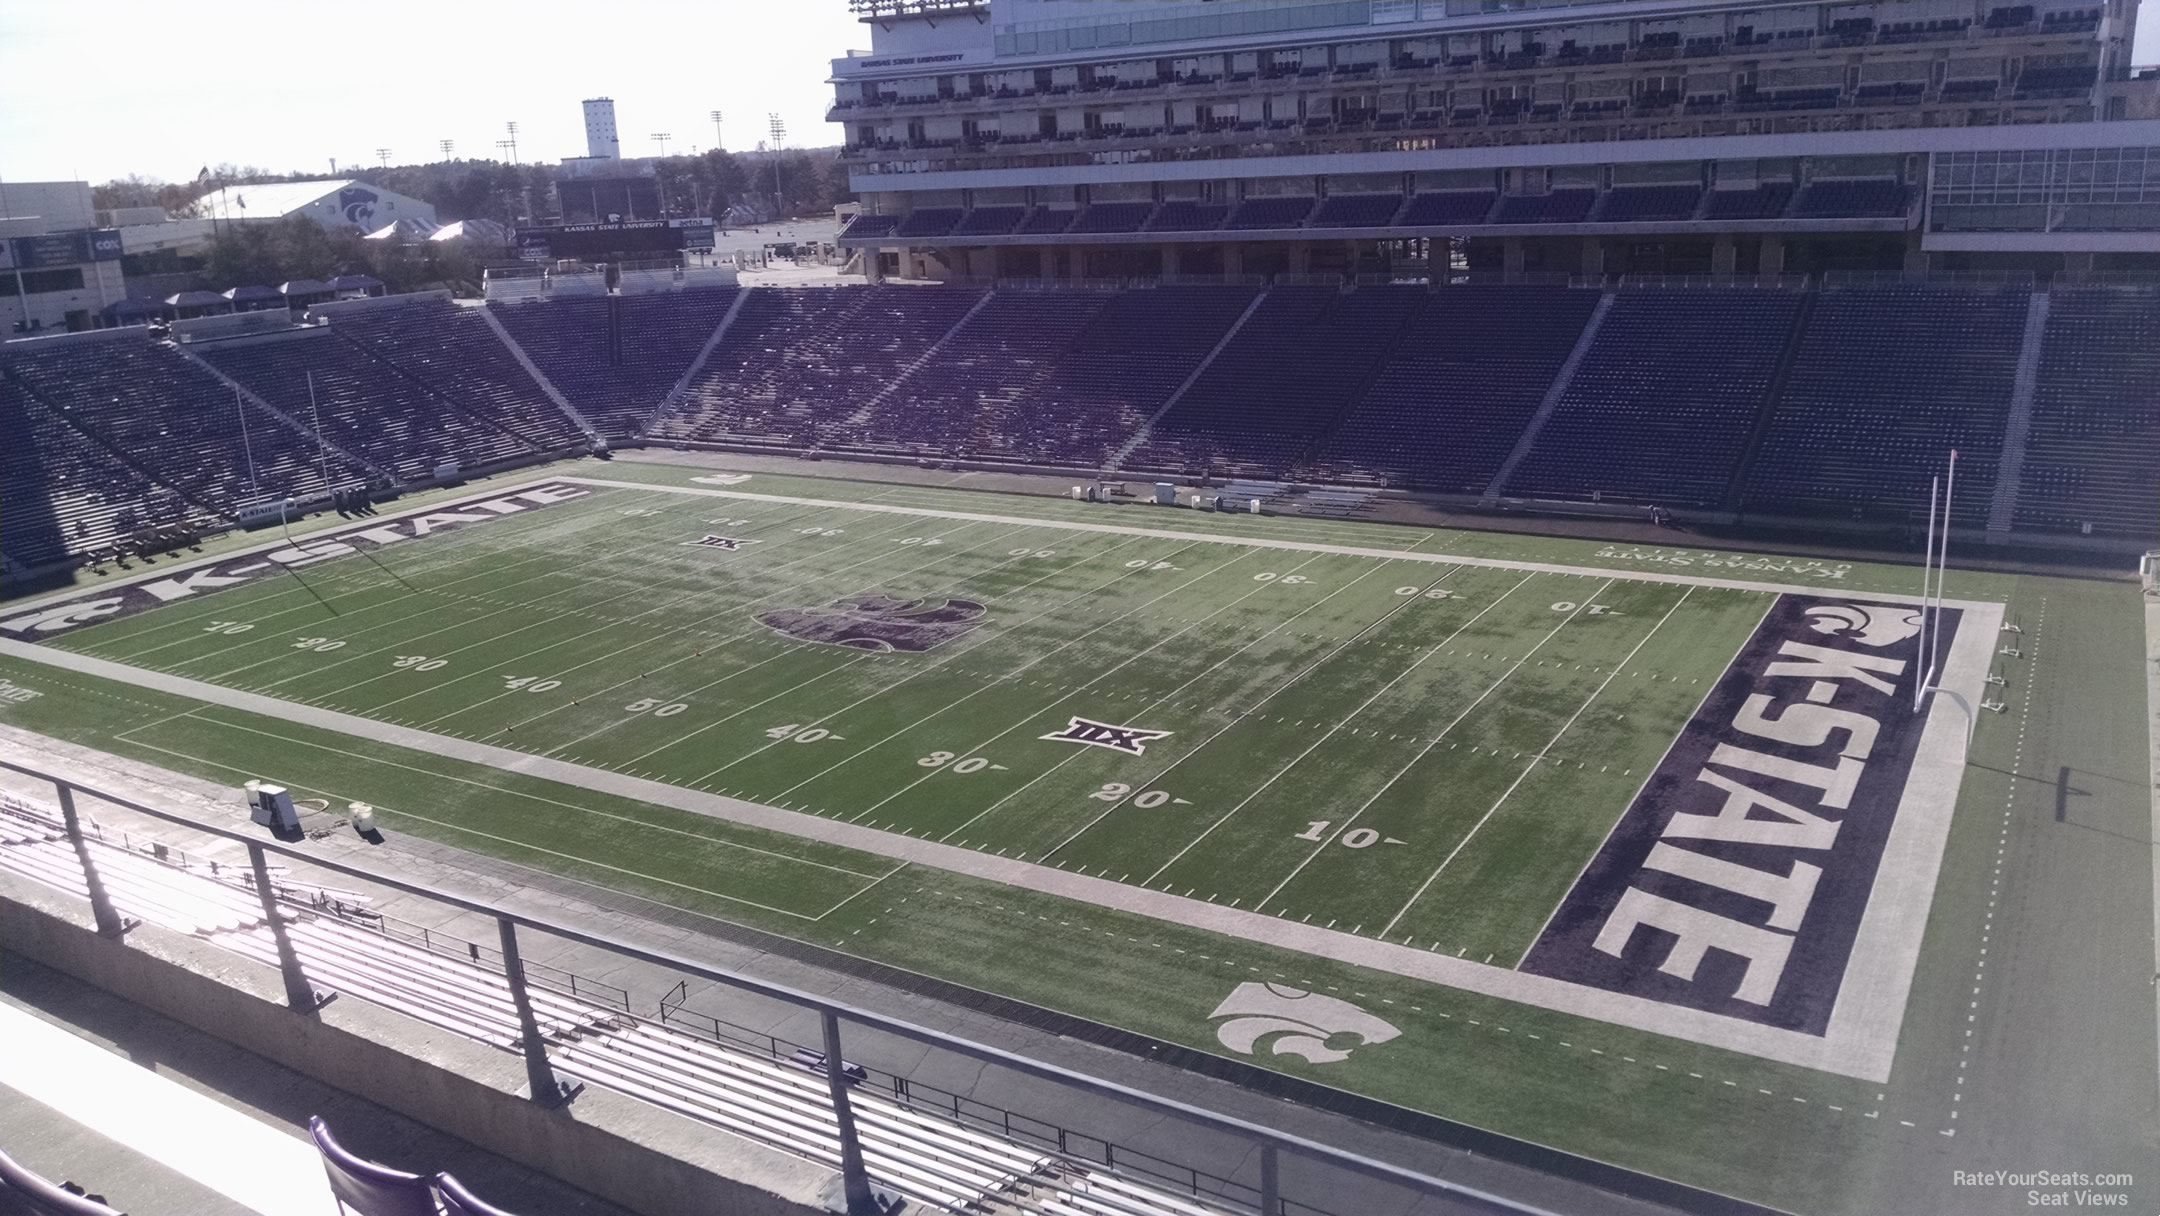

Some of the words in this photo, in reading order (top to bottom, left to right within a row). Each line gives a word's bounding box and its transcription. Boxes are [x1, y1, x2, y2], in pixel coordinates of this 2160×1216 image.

[893, 57, 915, 65] STATE
[917, 54, 964, 63] UNIVERSITY
[564, 225, 596, 233] KANSAS
[598, 223, 620, 231] STATE
[622, 221, 665, 229] UNIVERSITY
[139, 483, 591, 602] K-STATE
[898, 535, 943, 548] 40
[1007, 547, 1056, 558] 50
[1124, 558, 1173, 572] 40
[1253, 571, 1308, 586] 30
[1394, 585, 1453, 600] 20
[1549, 600, 1612, 616] 10
[206, 620, 255, 636] 10
[294, 636, 347, 652] 20
[393, 655, 448, 672] 30
[503, 674, 563, 693] 40
[624, 697, 689, 718] 50
[765, 722, 831, 745] 40
[916, 750, 990, 775] 30
[1089, 782, 1170, 809] 20
[1592, 640, 1907, 1007] K-STATE
[1294, 819, 1380, 849] 10
